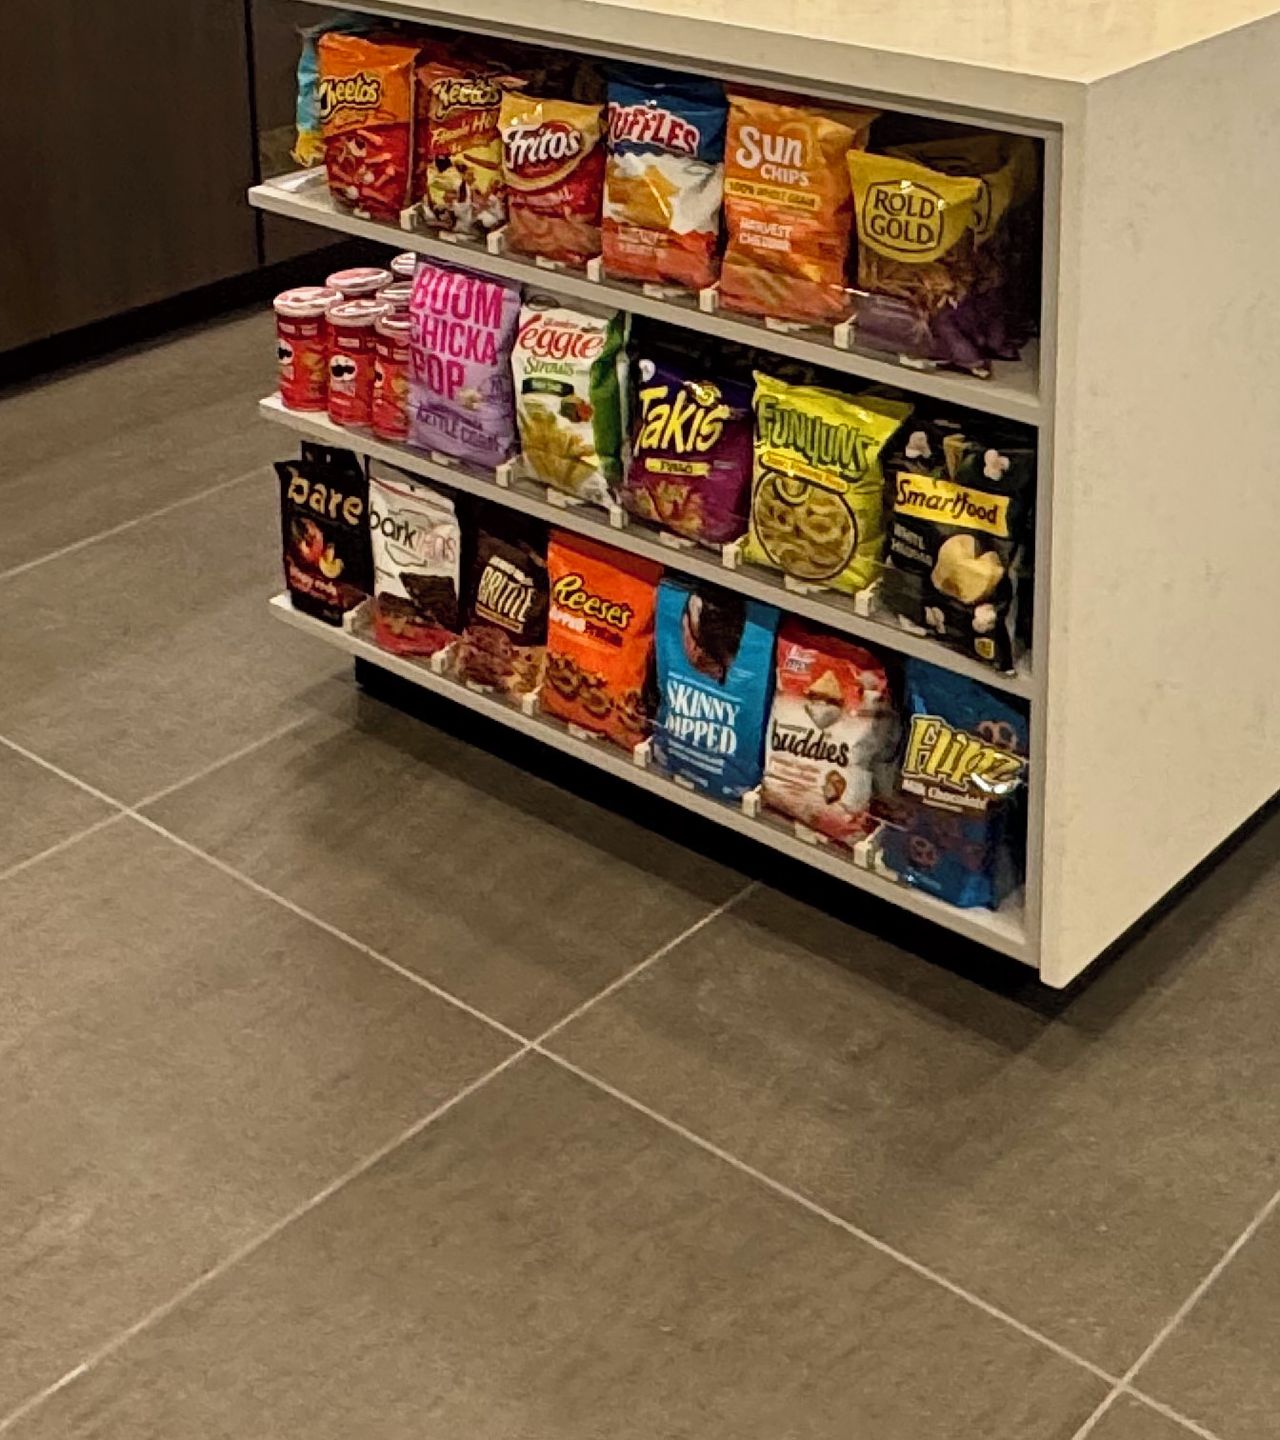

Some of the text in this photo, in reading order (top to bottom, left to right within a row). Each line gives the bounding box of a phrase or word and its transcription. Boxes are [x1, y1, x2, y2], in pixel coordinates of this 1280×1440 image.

[314, 76, 381, 120] Cheetos
[503, 126, 581, 169] Fritos
[735, 126, 802, 170] Sun
[760, 163, 810, 187] CHIPS
[871, 213, 936, 245] GOLD
[874, 189, 936, 220] ROLD
[409, 265, 505, 330] BOOM
[409, 310, 499, 367] CHICKA
[519, 313, 605, 360] Veggie
[410, 345, 466, 401] POP
[633, 385, 731, 458] Takis
[757, 396, 874, 483] FUNYUNS
[286, 465, 364, 527] bare
[895, 478, 999, 526] Smartfood
[554, 575, 633, 630] Reese's
[666, 679, 741, 728] SKINNY
[664, 712, 737, 757] DIPPED
[771, 718, 850, 767] buddies
[904, 716, 1025, 786] Flipz
